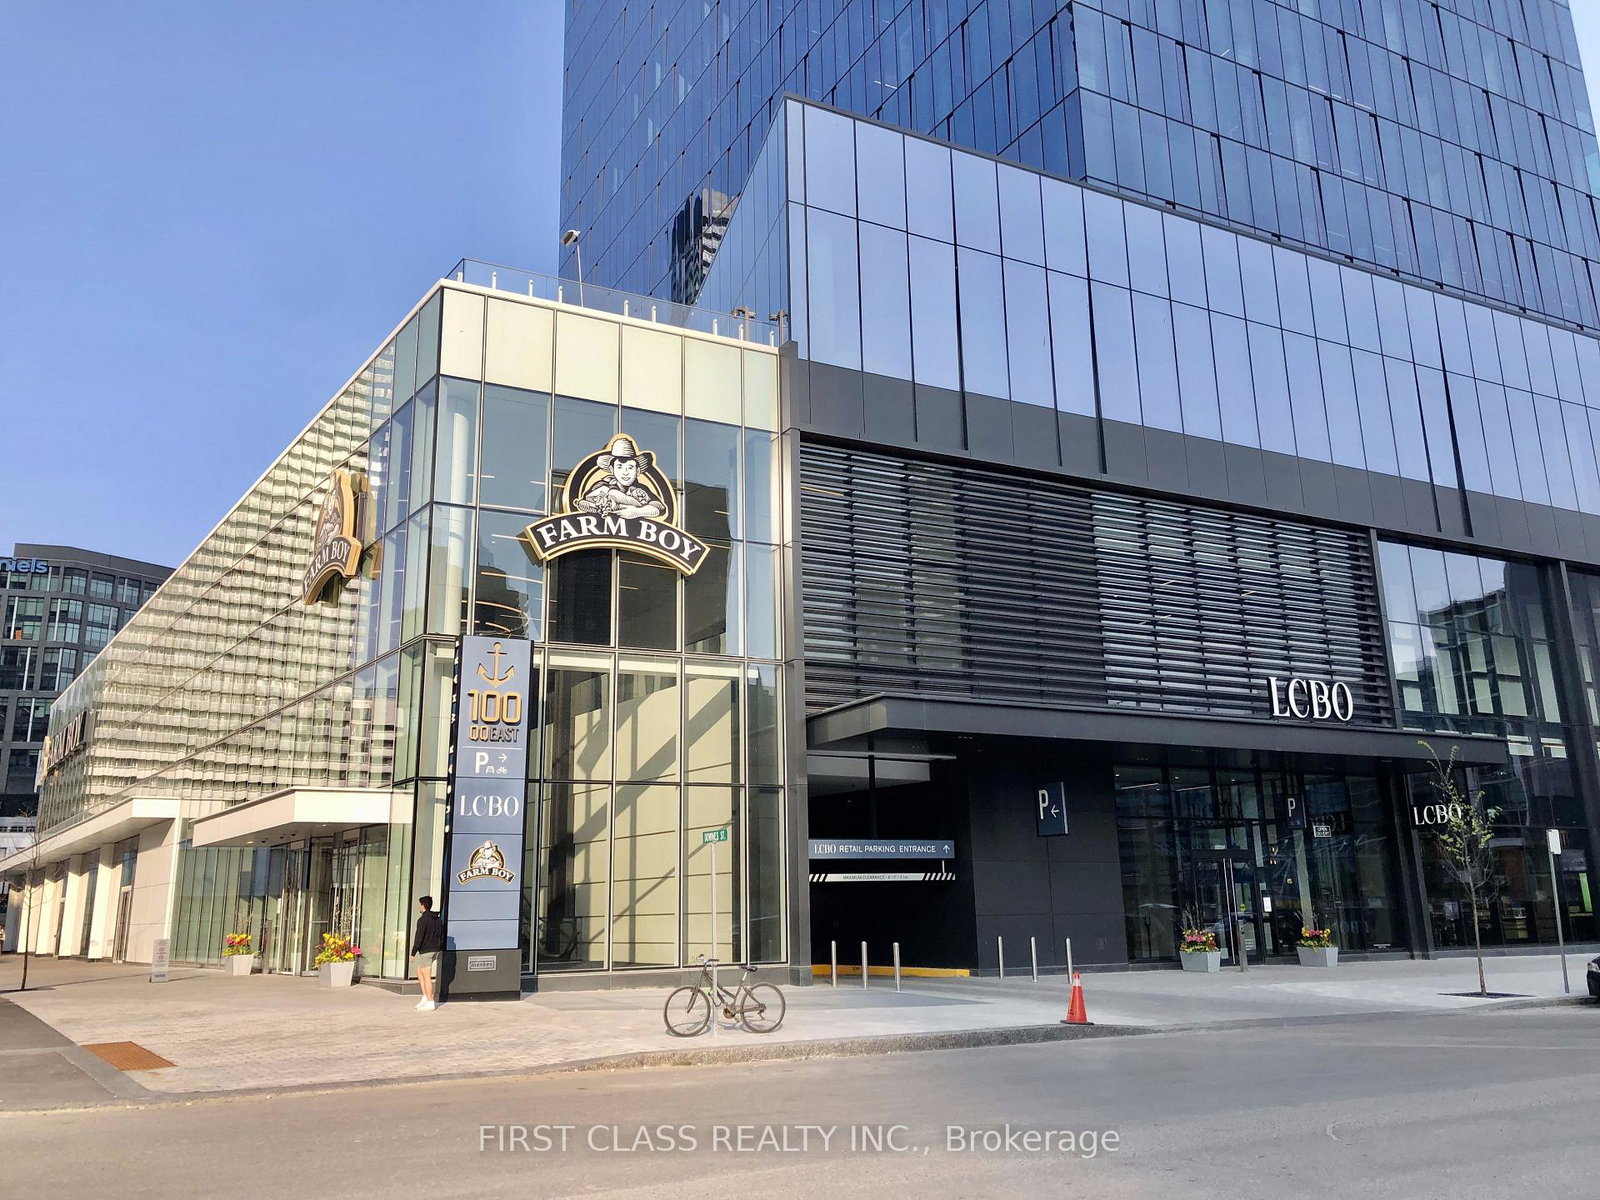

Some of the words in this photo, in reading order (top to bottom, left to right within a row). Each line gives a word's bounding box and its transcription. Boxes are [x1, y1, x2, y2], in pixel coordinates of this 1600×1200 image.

[536, 515, 630, 549] FARM
[636, 520, 702, 562] BOY
[303, 546, 330, 593] FARM
[330, 540, 350, 564] BOY
[467, 688, 522, 725] 100
[1268, 676, 1354, 721] LCBO
[475, 752, 489, 774] P
[459, 795, 519, 817] LCBO
[1038, 789, 1049, 820] P
[1287, 797, 1296, 817] P
[1413, 803, 1462, 825] LCBO
[814, 844, 836, 853] LCBO
[839, 845, 863, 853] RETAIL
[864, 845, 896, 853] PARKING
[899, 845, 936, 853] ENTRANCE
[459, 867, 489, 881] FARM
[491, 867, 513, 880] BOY
